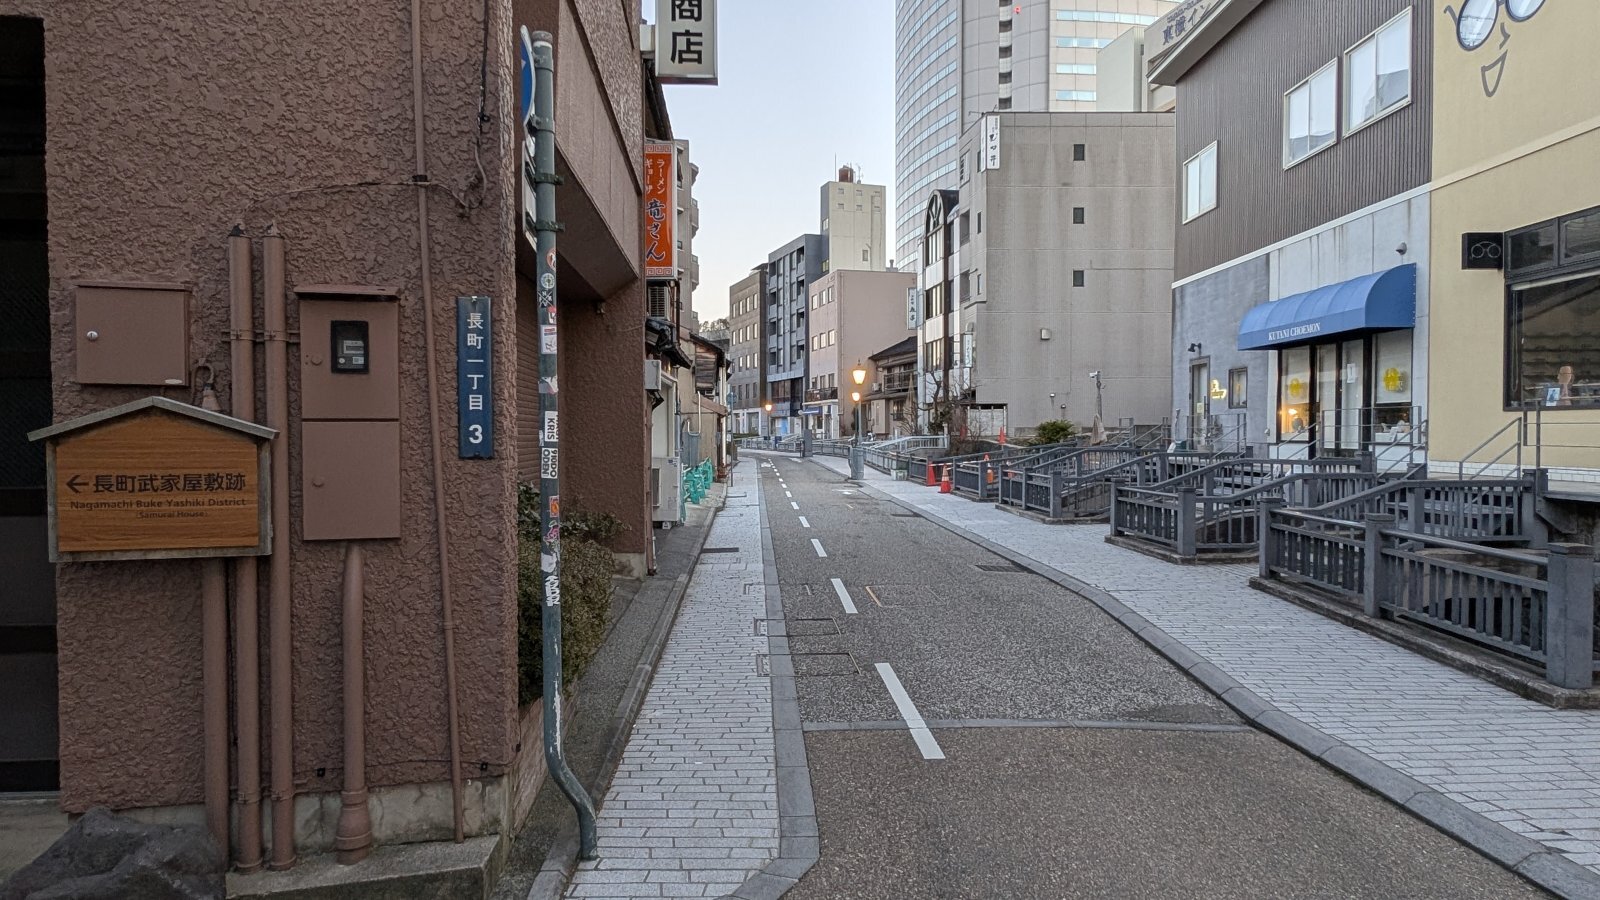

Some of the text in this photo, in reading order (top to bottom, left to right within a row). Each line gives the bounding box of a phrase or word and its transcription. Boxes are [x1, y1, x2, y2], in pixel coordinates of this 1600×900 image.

[671, 0, 702, 64] 商店
[657, 159, 665, 194] ラーメン
[1268, 322, 1321, 341] KUTANI CHOEMON
[547, 417, 556, 440] KRIS
[93, 473, 246, 493] 長町武家屋敷跡
[70, 498, 247, 511] Nagamachi Buke Yashiki District
